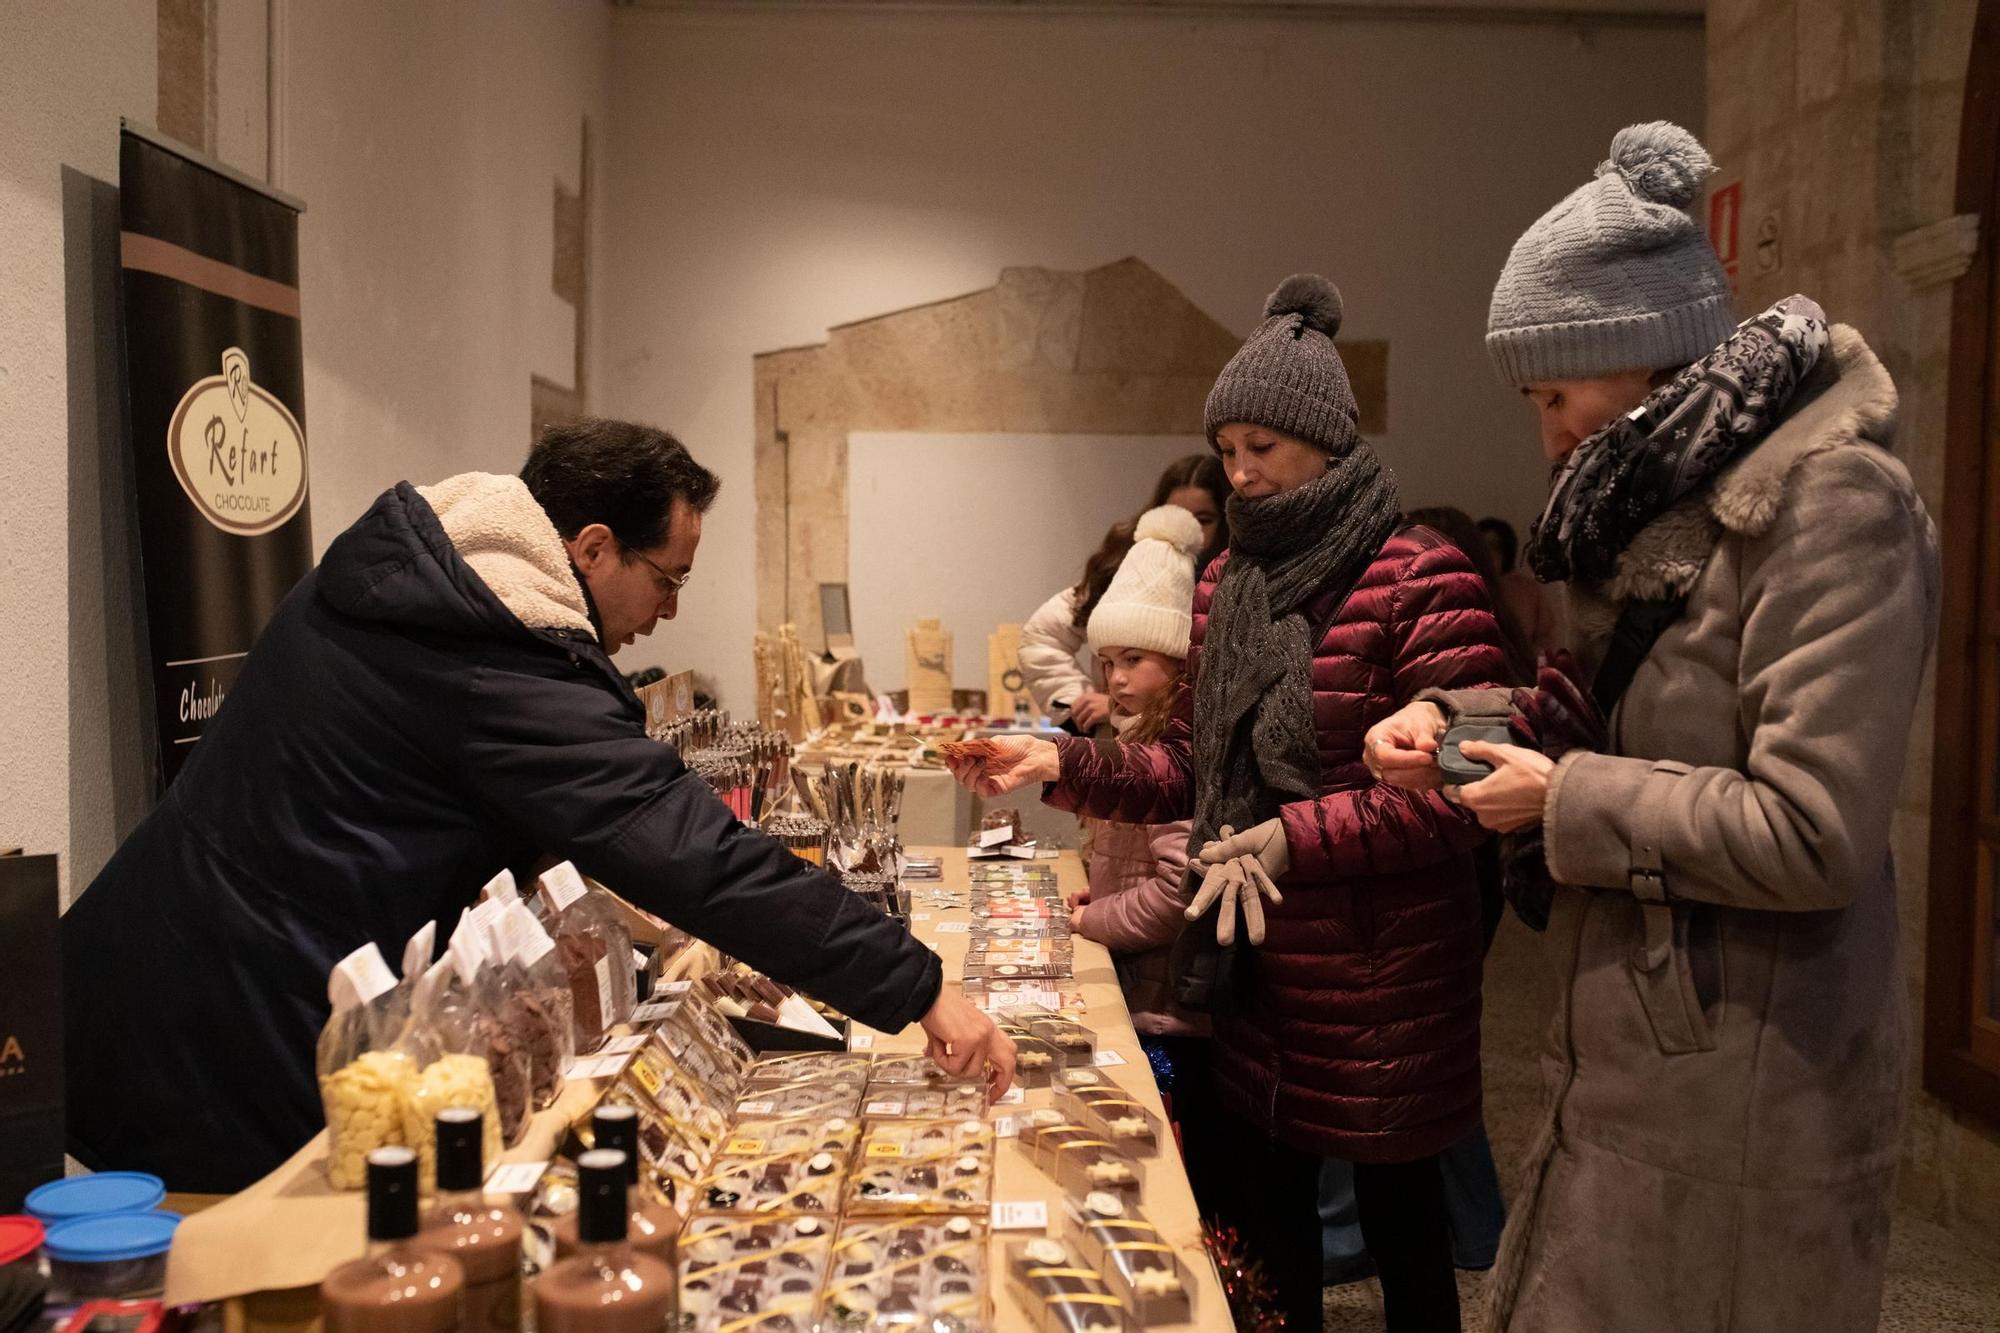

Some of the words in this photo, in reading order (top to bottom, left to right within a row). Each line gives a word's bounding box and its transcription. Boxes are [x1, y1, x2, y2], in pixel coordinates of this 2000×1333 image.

[204, 414, 278, 487] Refart
[214, 493, 271, 513] CHOCOLATE
[180, 677, 225, 722] Chocolat
